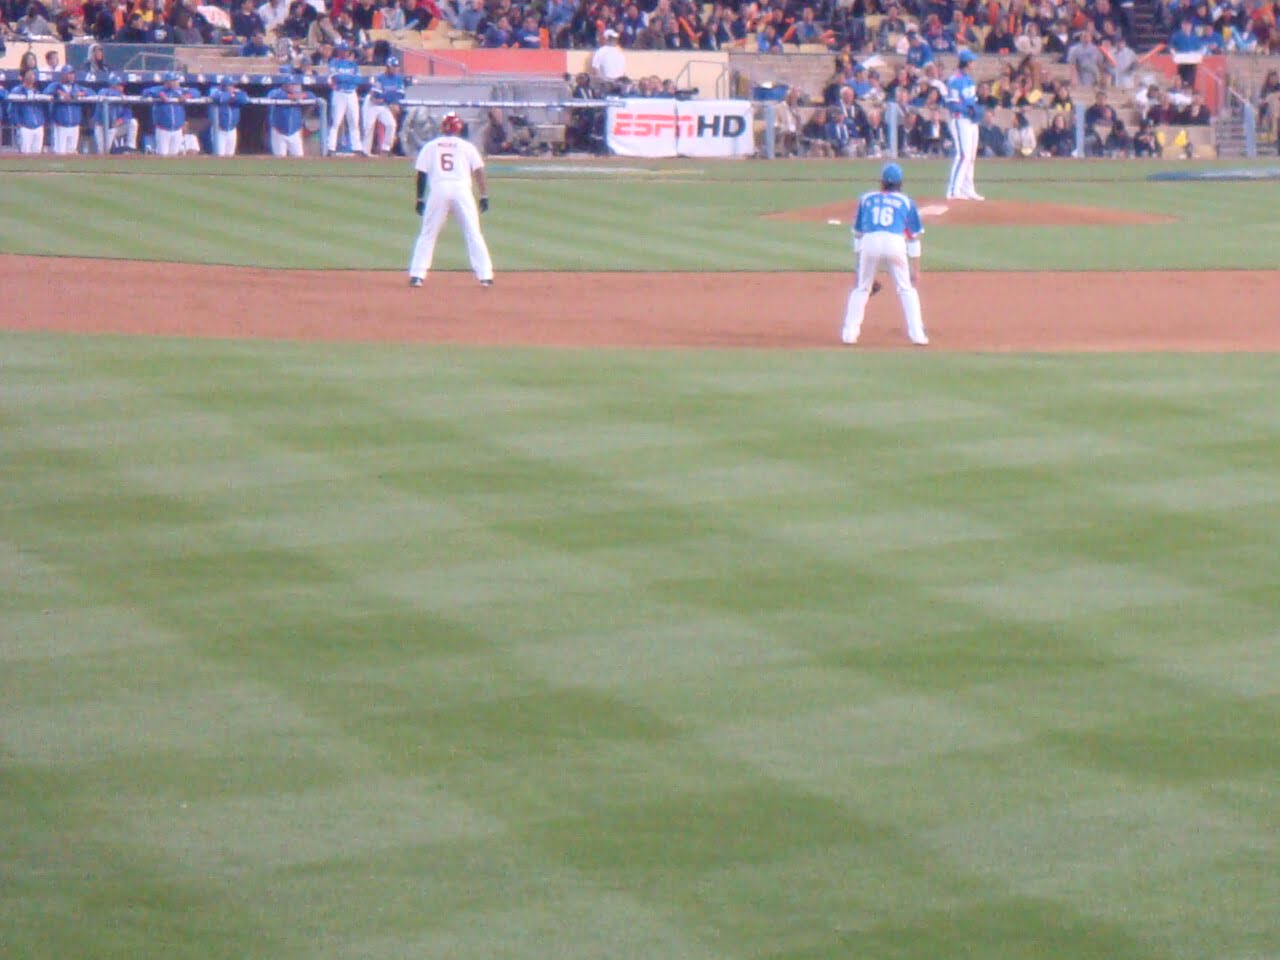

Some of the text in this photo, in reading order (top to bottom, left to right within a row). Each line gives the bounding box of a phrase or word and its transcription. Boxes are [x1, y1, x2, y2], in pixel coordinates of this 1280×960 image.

[613, 113, 746, 137] ESPN HD
[441, 153, 454, 171] 6
[872, 206, 894, 227] 16
